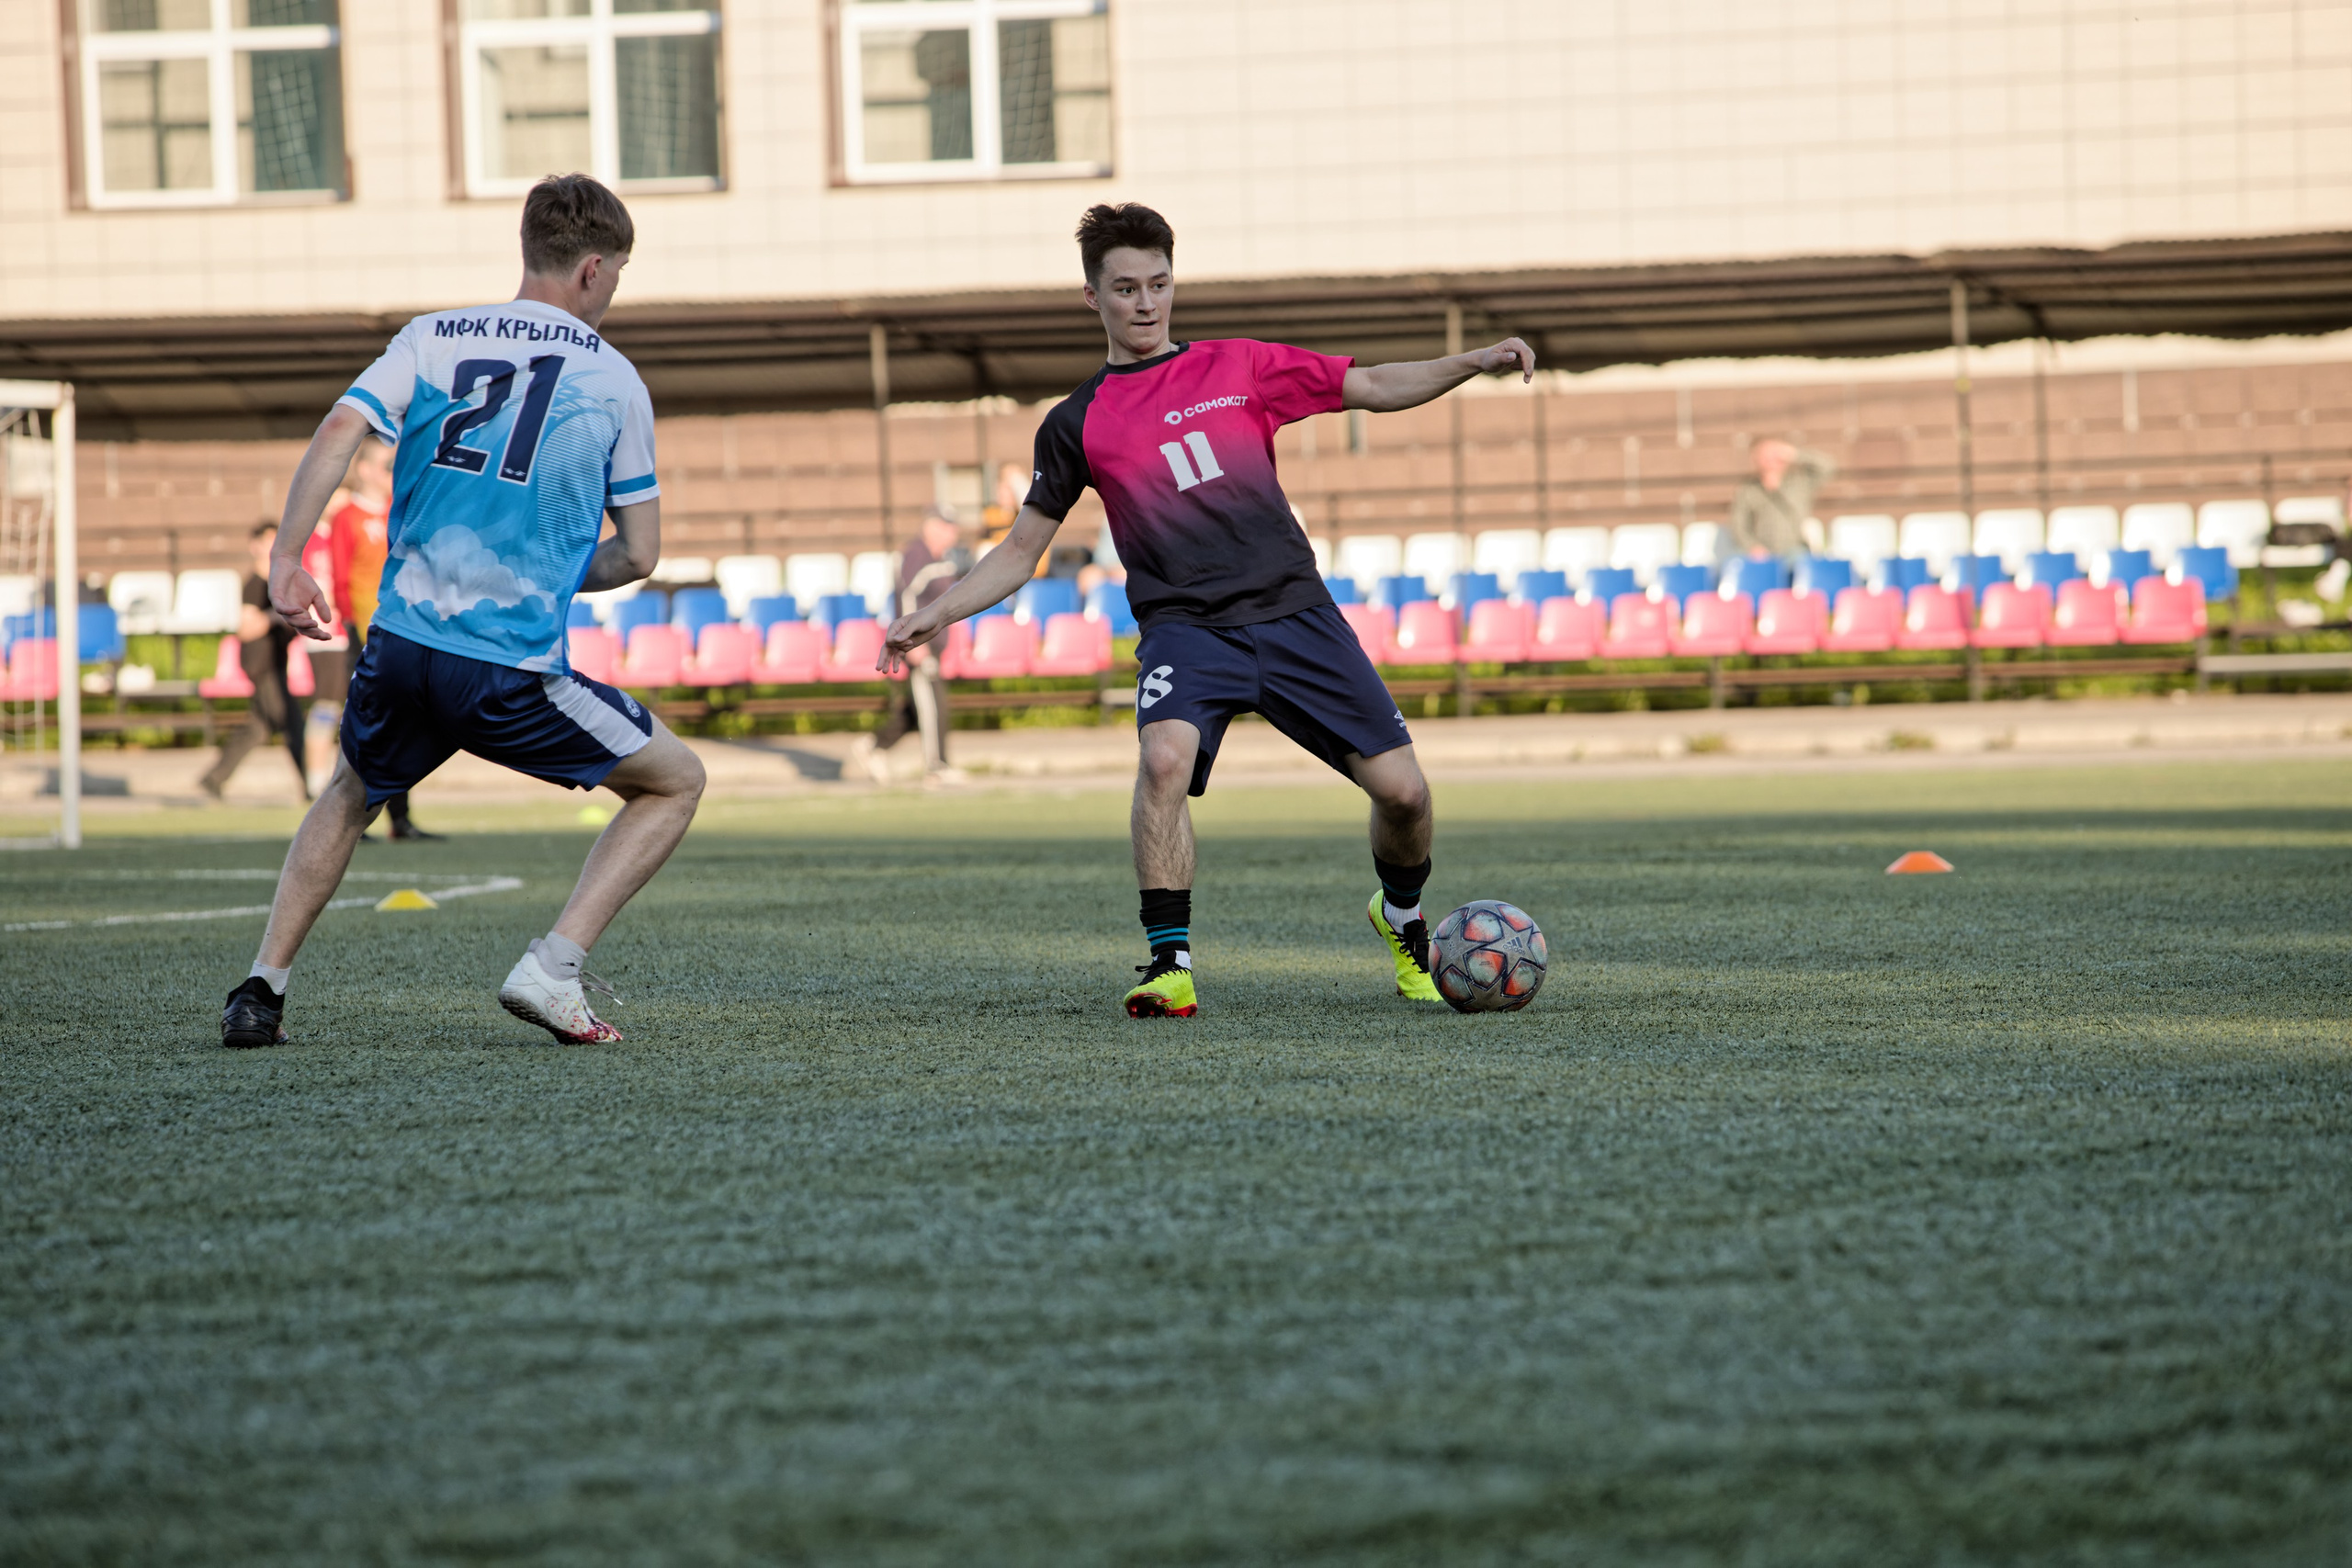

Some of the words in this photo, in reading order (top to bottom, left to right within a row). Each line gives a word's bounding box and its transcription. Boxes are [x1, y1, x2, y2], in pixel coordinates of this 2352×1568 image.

[435, 317, 491, 338] МФК
[496, 318, 600, 353] КРЫЛЬЯ
[431, 355, 566, 485] 21
[1159, 431, 1225, 492] 11
[1136, 665, 1174, 713] 8
